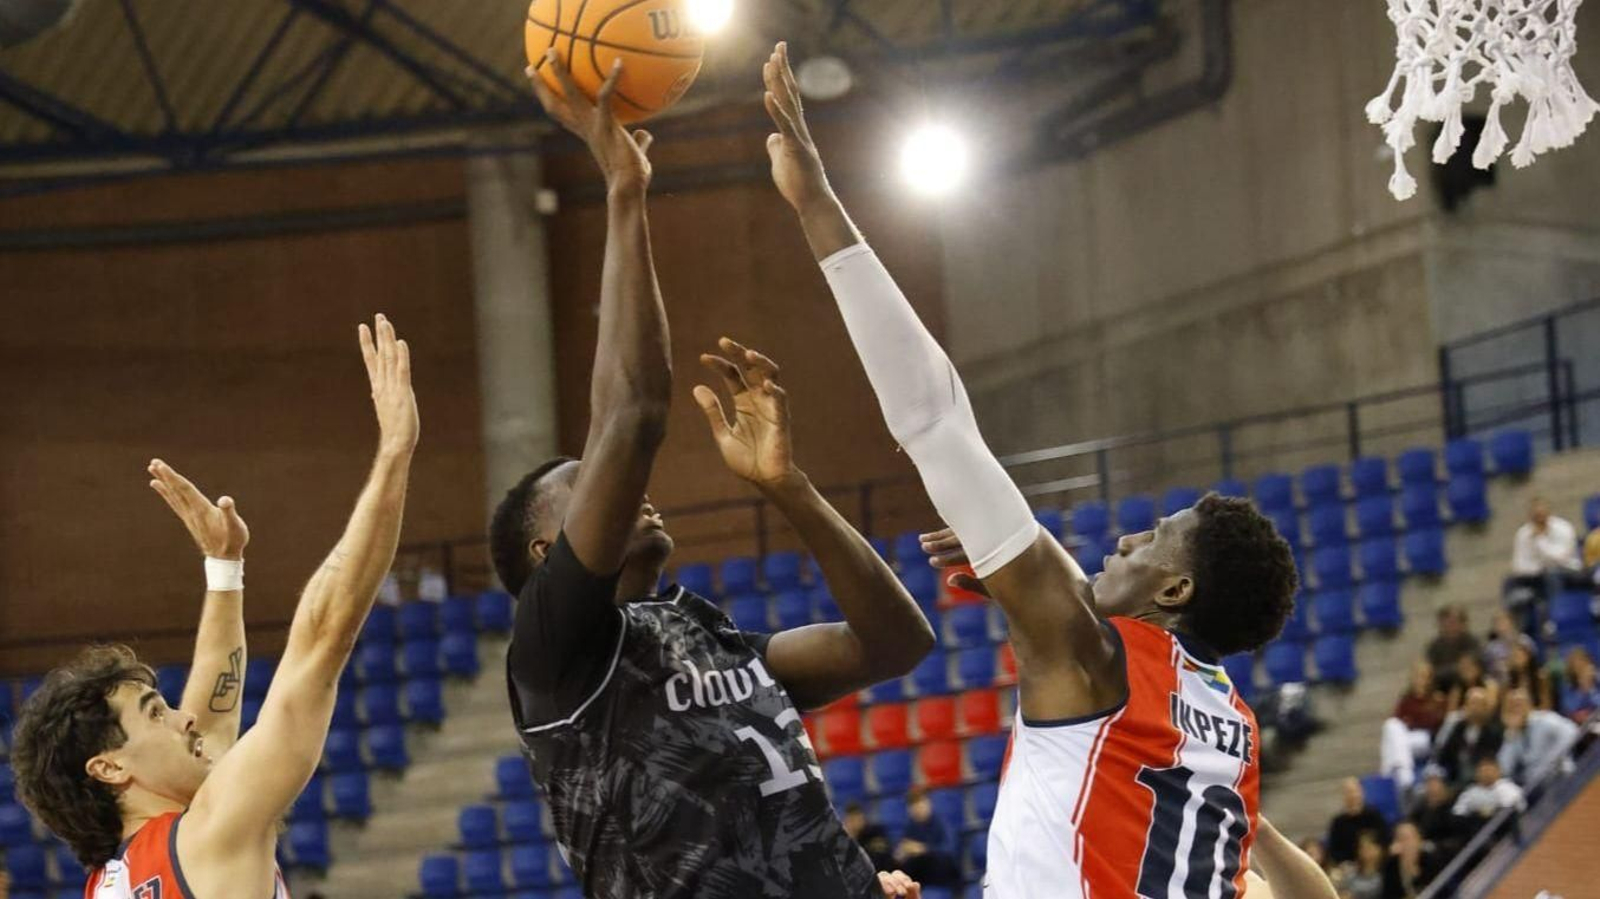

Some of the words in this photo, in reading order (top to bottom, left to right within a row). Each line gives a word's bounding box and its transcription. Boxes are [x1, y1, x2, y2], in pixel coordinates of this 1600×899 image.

[665, 657, 786, 711] clavi
[1170, 692, 1254, 765] IKPEZE
[1136, 765, 1249, 899] 10
